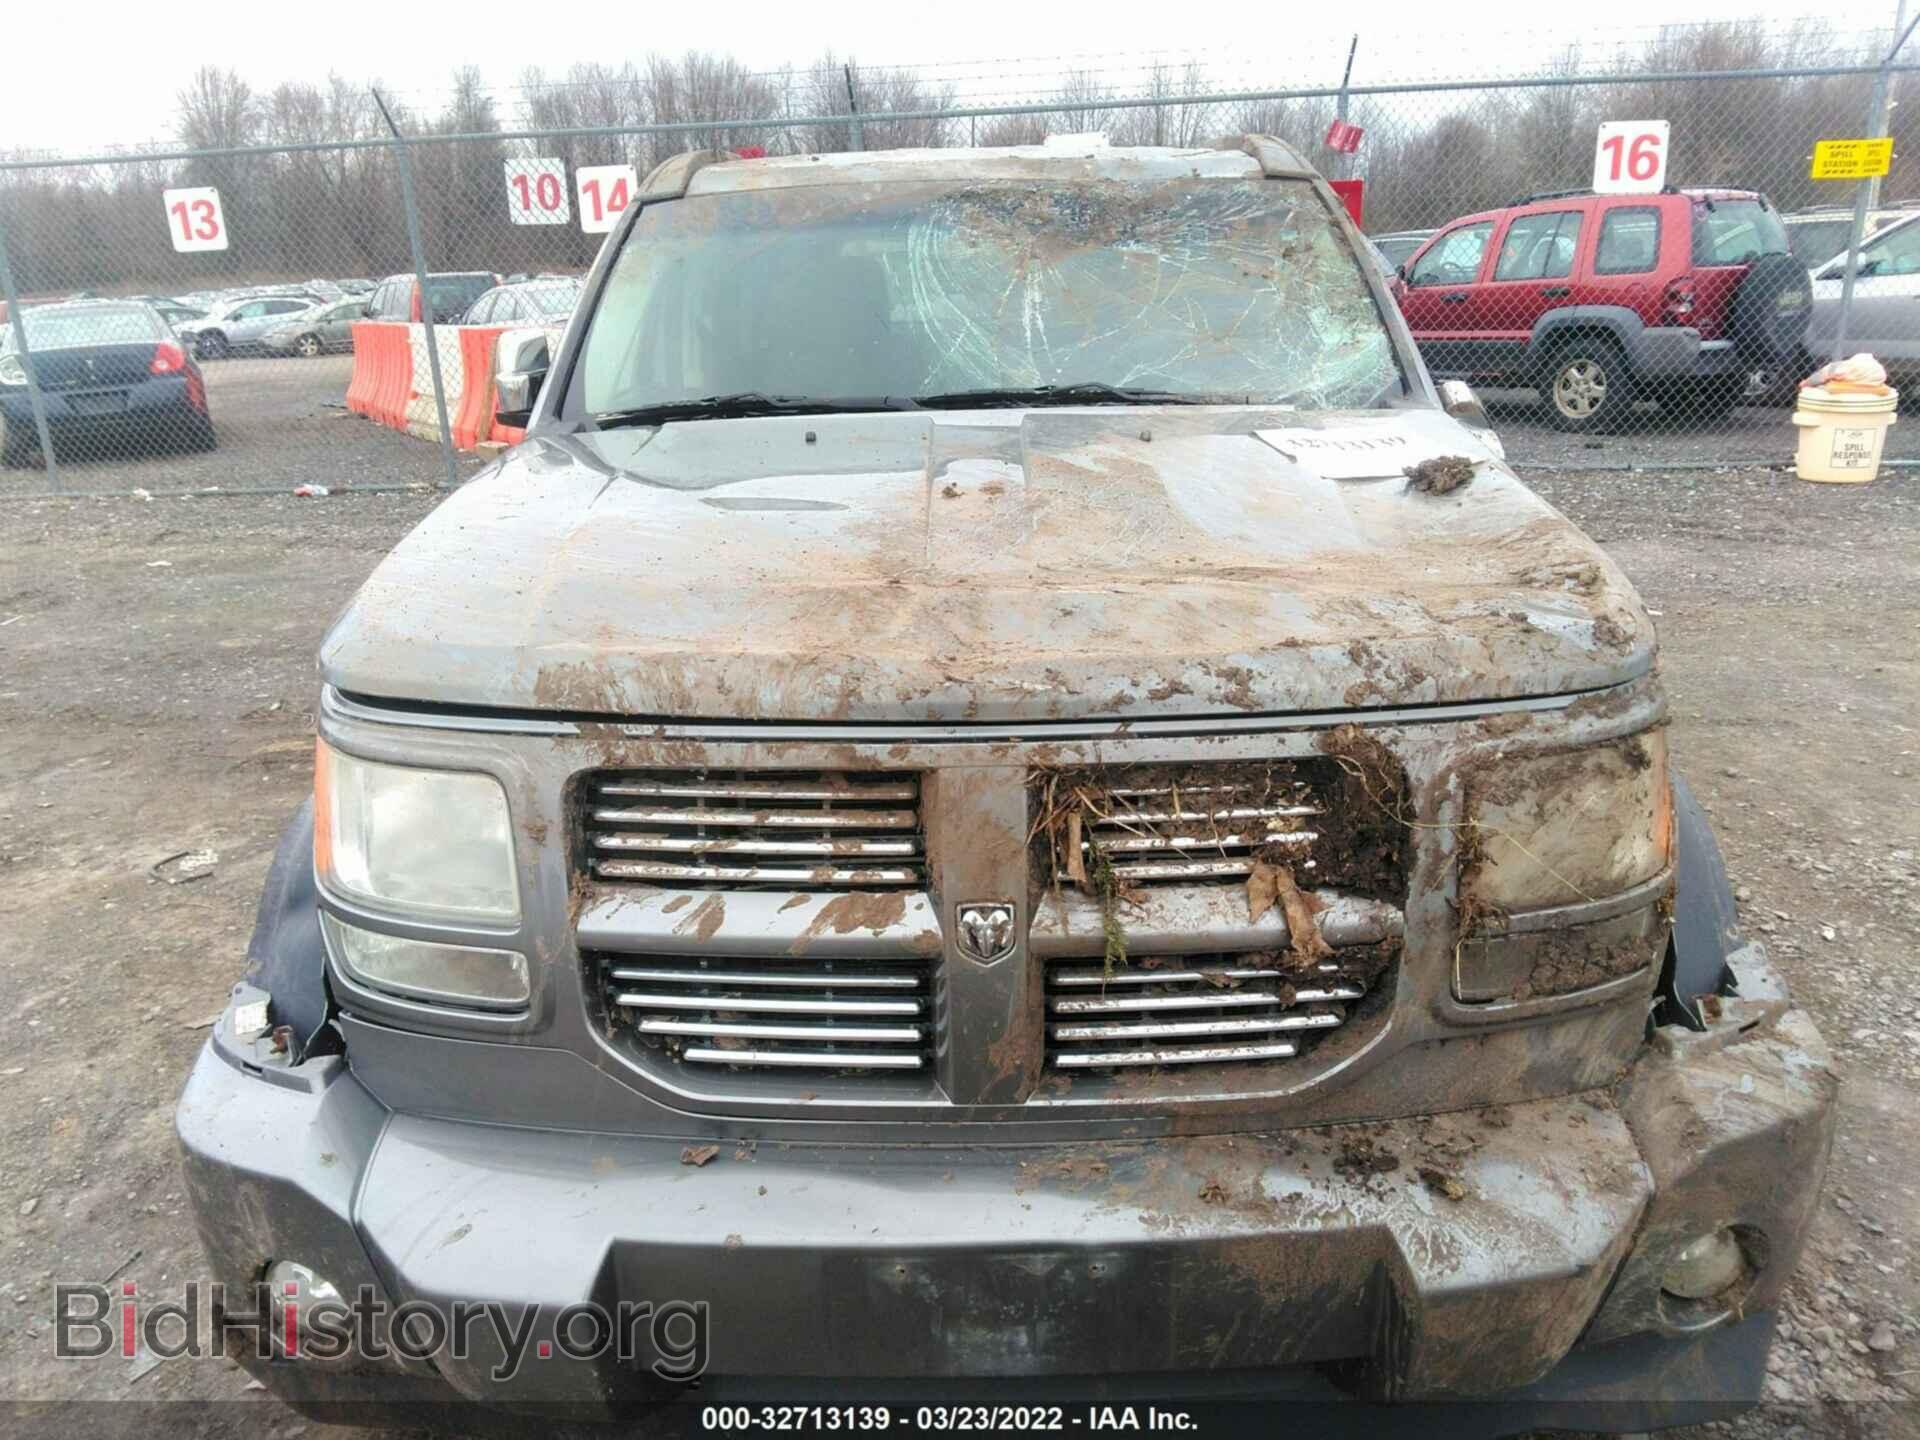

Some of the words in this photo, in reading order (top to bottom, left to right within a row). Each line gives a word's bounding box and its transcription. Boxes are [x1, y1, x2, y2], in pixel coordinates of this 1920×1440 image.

[1602, 133, 1661, 181] 16
[512, 172, 562, 212] 10
[582, 178, 629, 221] 14
[171, 199, 219, 241] 13
[1844, 443, 1864, 451] SPILL
